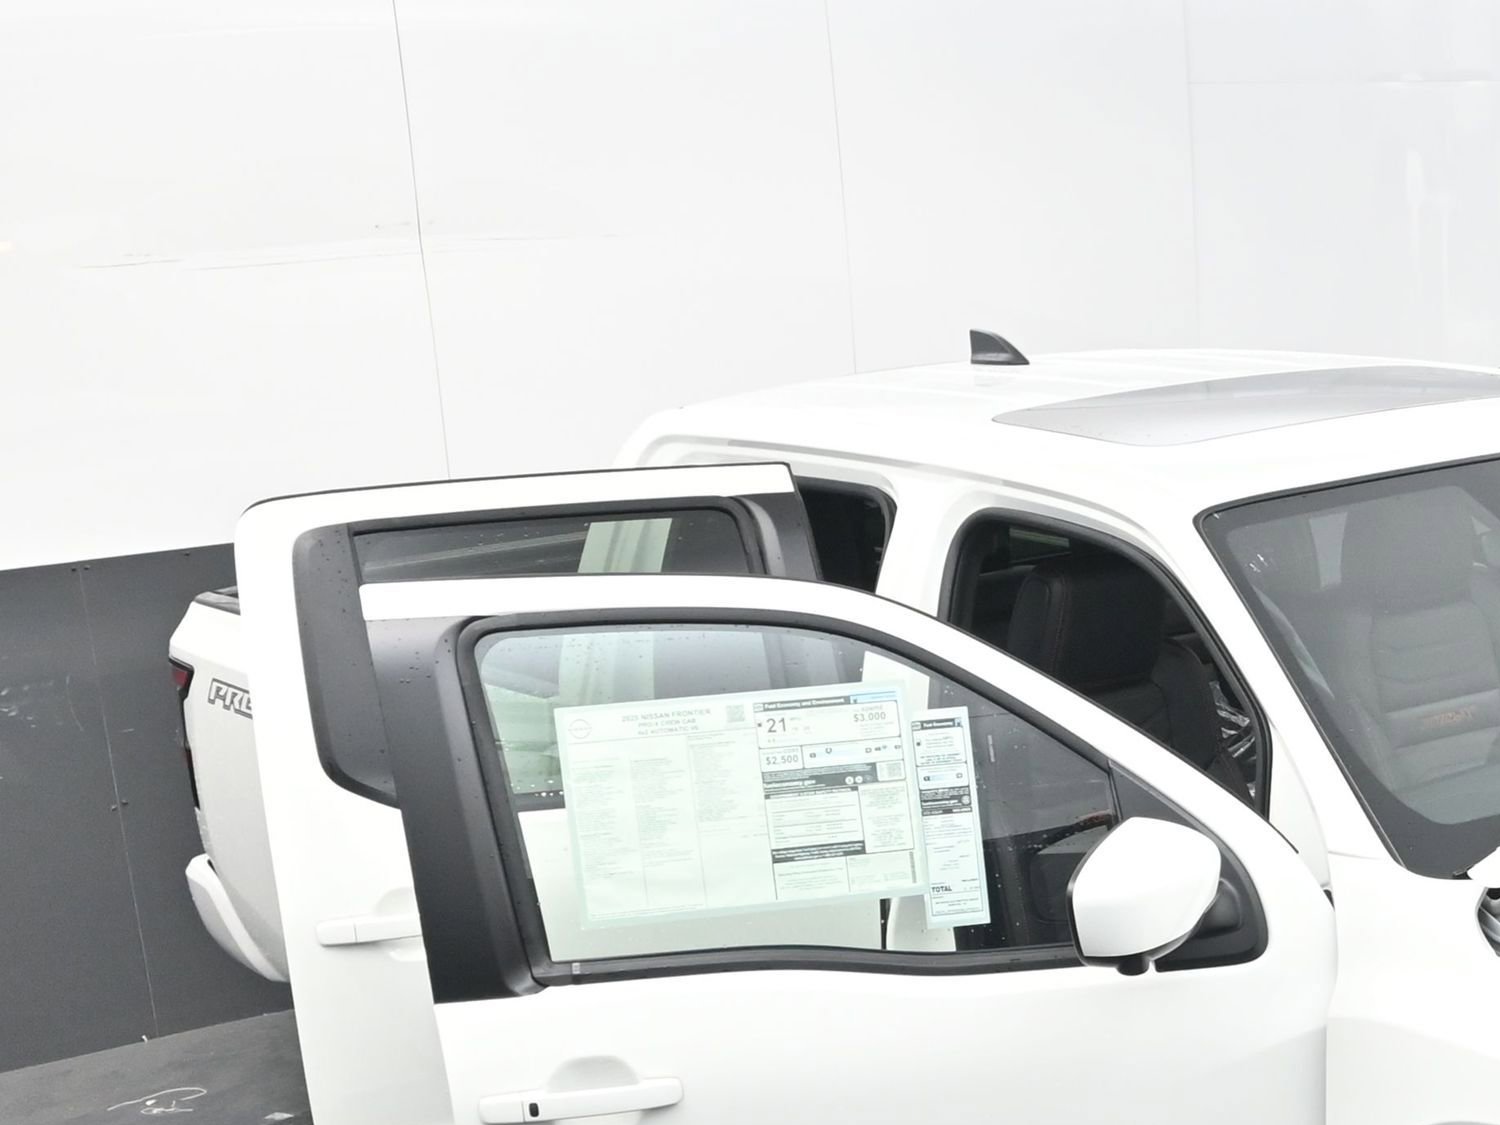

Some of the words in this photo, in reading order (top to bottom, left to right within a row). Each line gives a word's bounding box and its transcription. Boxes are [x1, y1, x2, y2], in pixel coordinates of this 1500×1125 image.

[640, 712, 670, 720] NISSAN
[671, 708, 711, 718] FRONTIER
[650, 726, 688, 734] AUTOMATIC
[766, 717, 787, 734] 21
[931, 885, 953, 893] TOTAL
